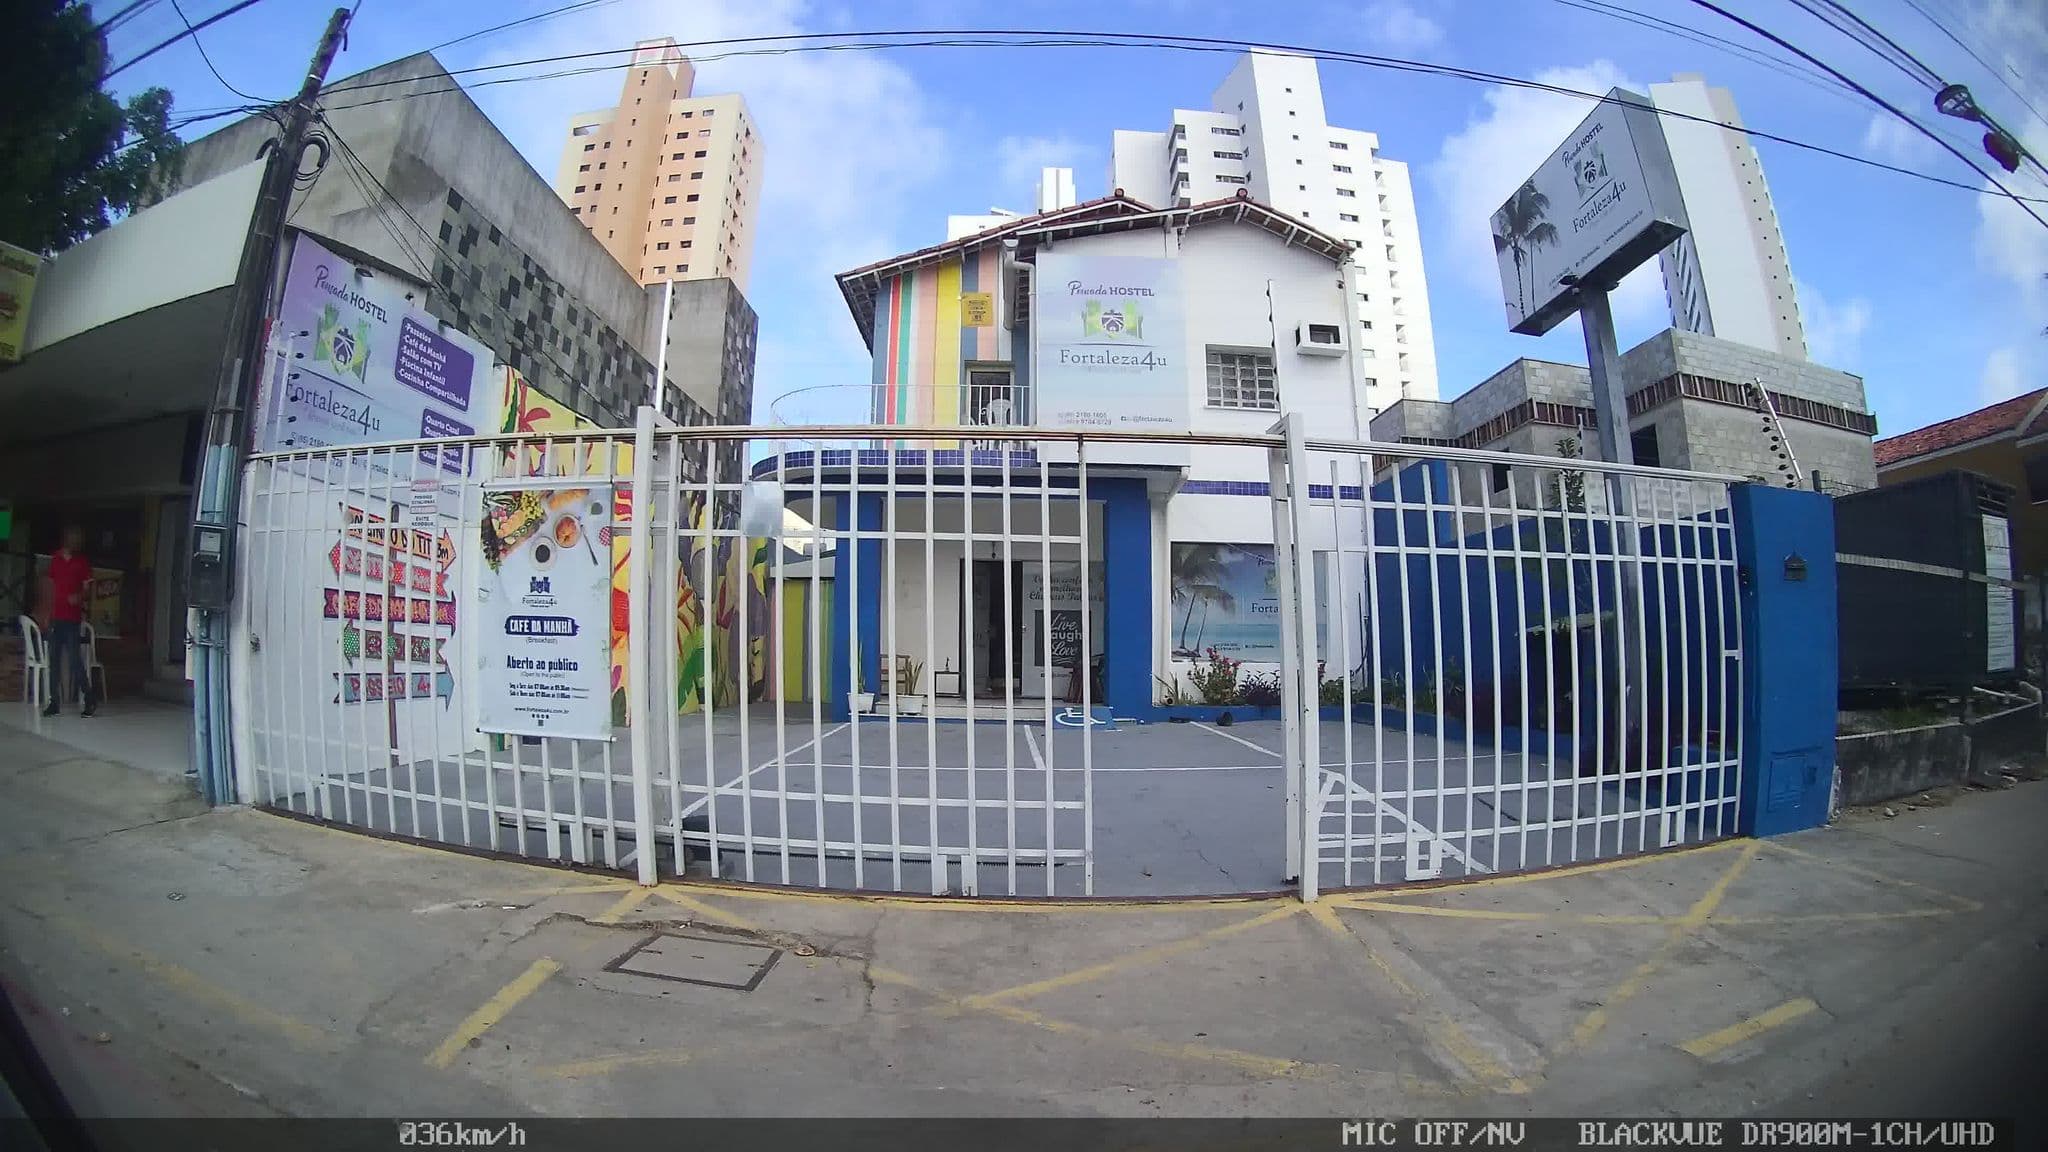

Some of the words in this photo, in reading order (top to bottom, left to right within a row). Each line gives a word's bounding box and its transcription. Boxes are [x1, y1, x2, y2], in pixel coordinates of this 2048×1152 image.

[1580, 123, 1603, 148] HOSTEL
[1573, 181, 1626, 233] Fortaleza4u
[1109, 287, 1155, 297] HOSTEL
[350, 292, 388, 323] HOSTEL
[420, 357, 432, 367] com
[433, 362, 442, 371] TV
[1060, 349, 1167, 371] Fortaleza4u
[285, 378, 380, 435] Fortaleza4u
[1251, 602, 1279, 613] Forta
[531, 620, 541, 633] DA
[1051, 613, 1077, 630] Live
[1051, 630, 1084, 642] augh
[1051, 641, 1078, 656] Love
[506, 655, 533, 669] Aberto
[536, 660, 546, 670] ao
[548, 658, 578, 672] publico
